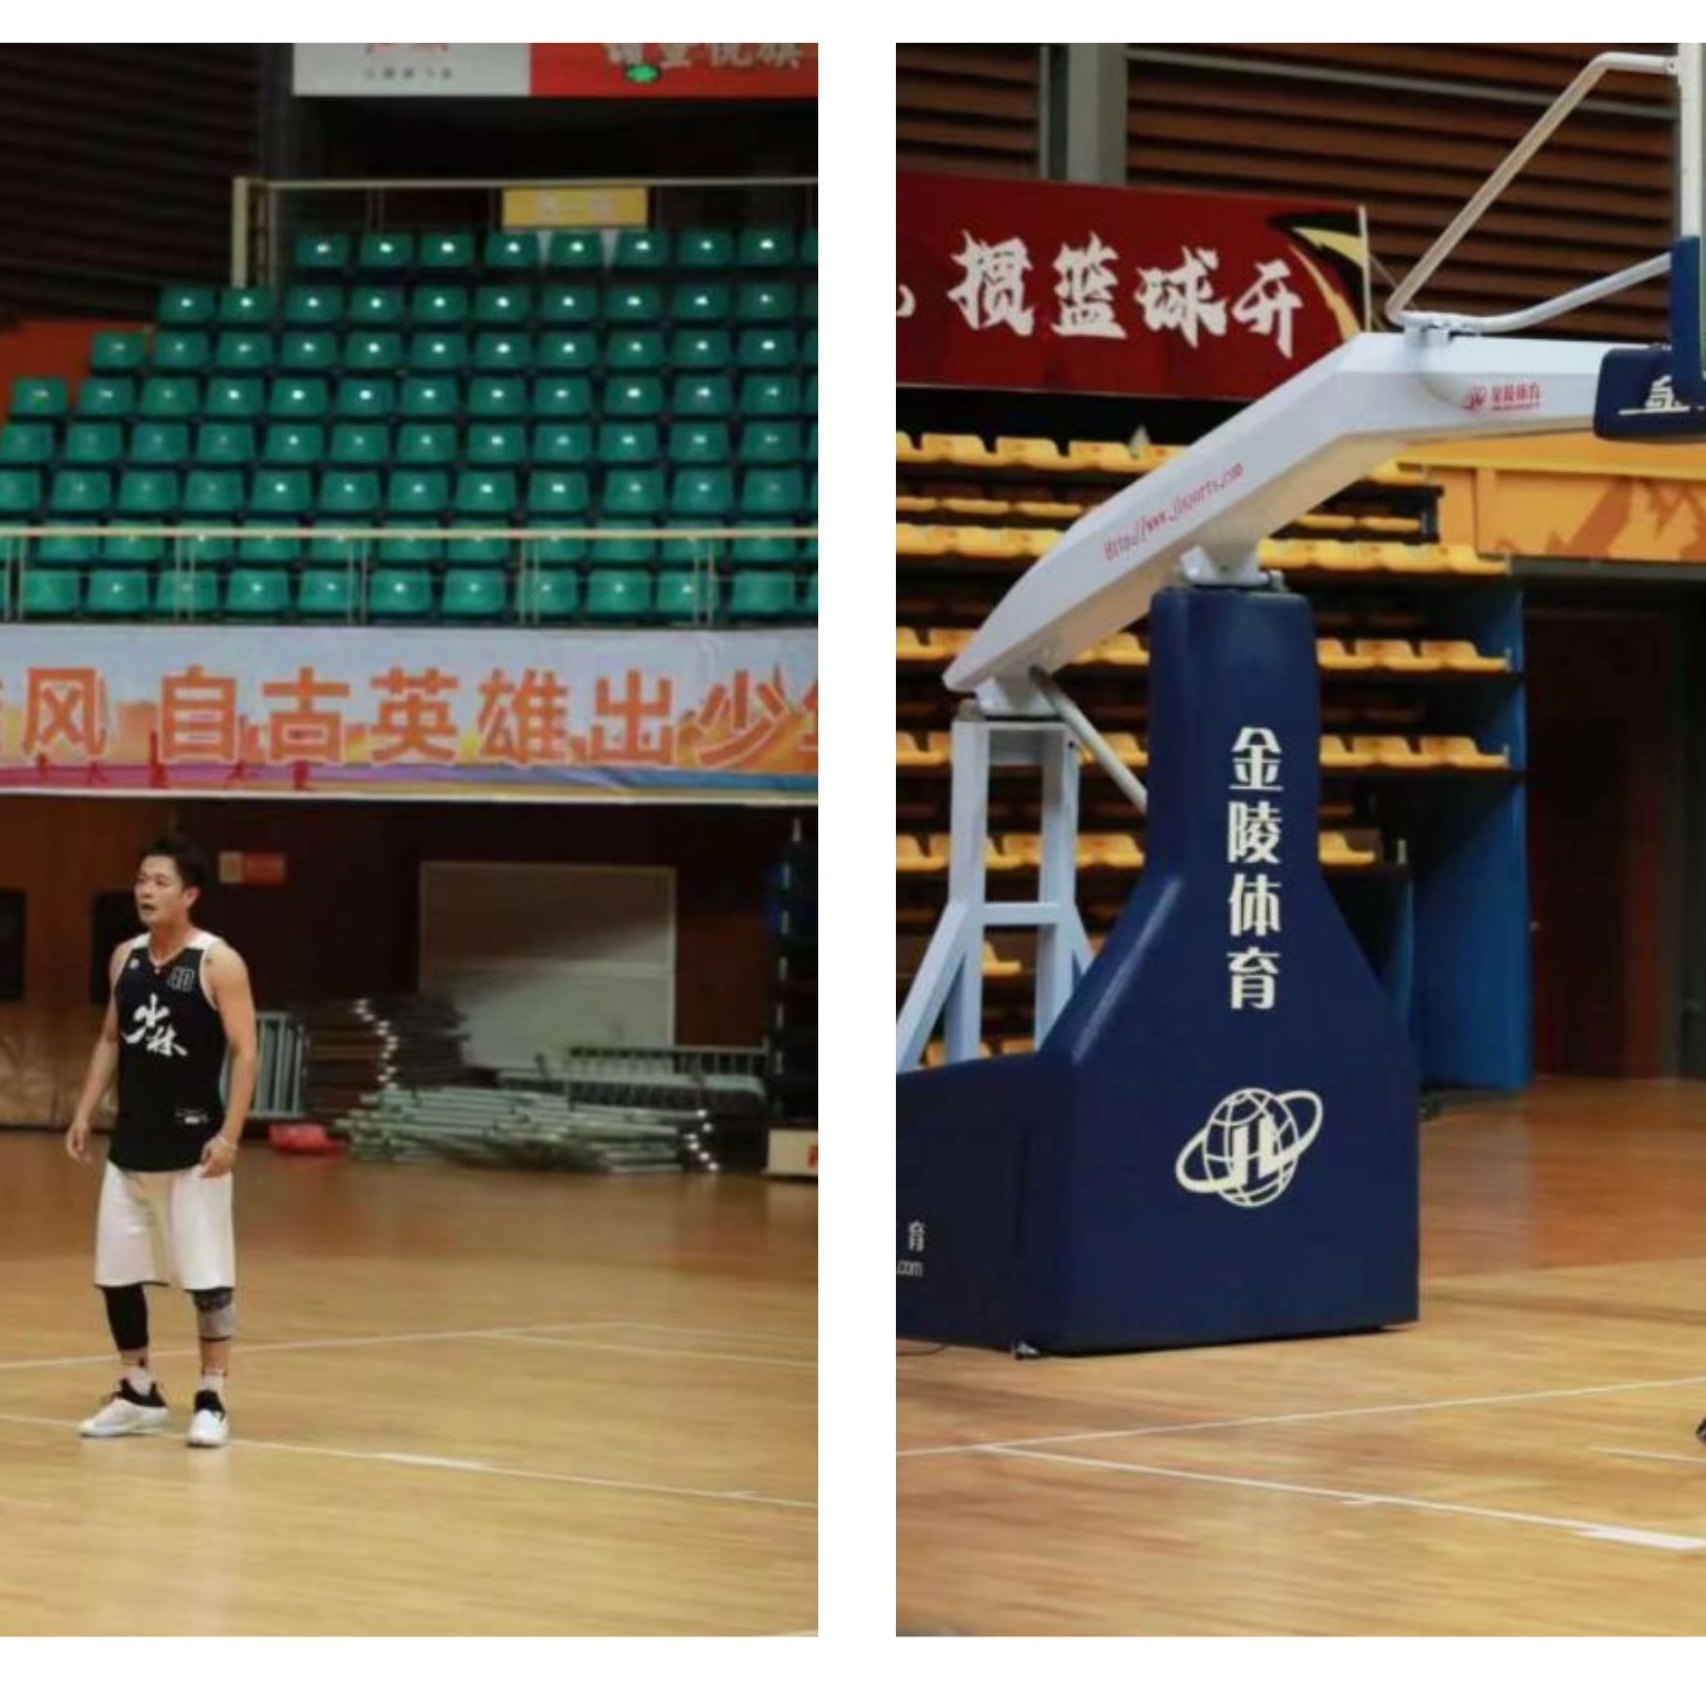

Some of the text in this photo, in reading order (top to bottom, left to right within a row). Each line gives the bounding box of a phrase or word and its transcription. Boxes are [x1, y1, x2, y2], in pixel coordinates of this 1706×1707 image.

[159, 664, 818, 767] 自古英雄出少
[1227, 726, 1285, 1010] 金陵体育
[121, 992, 189, 1057] 少林
